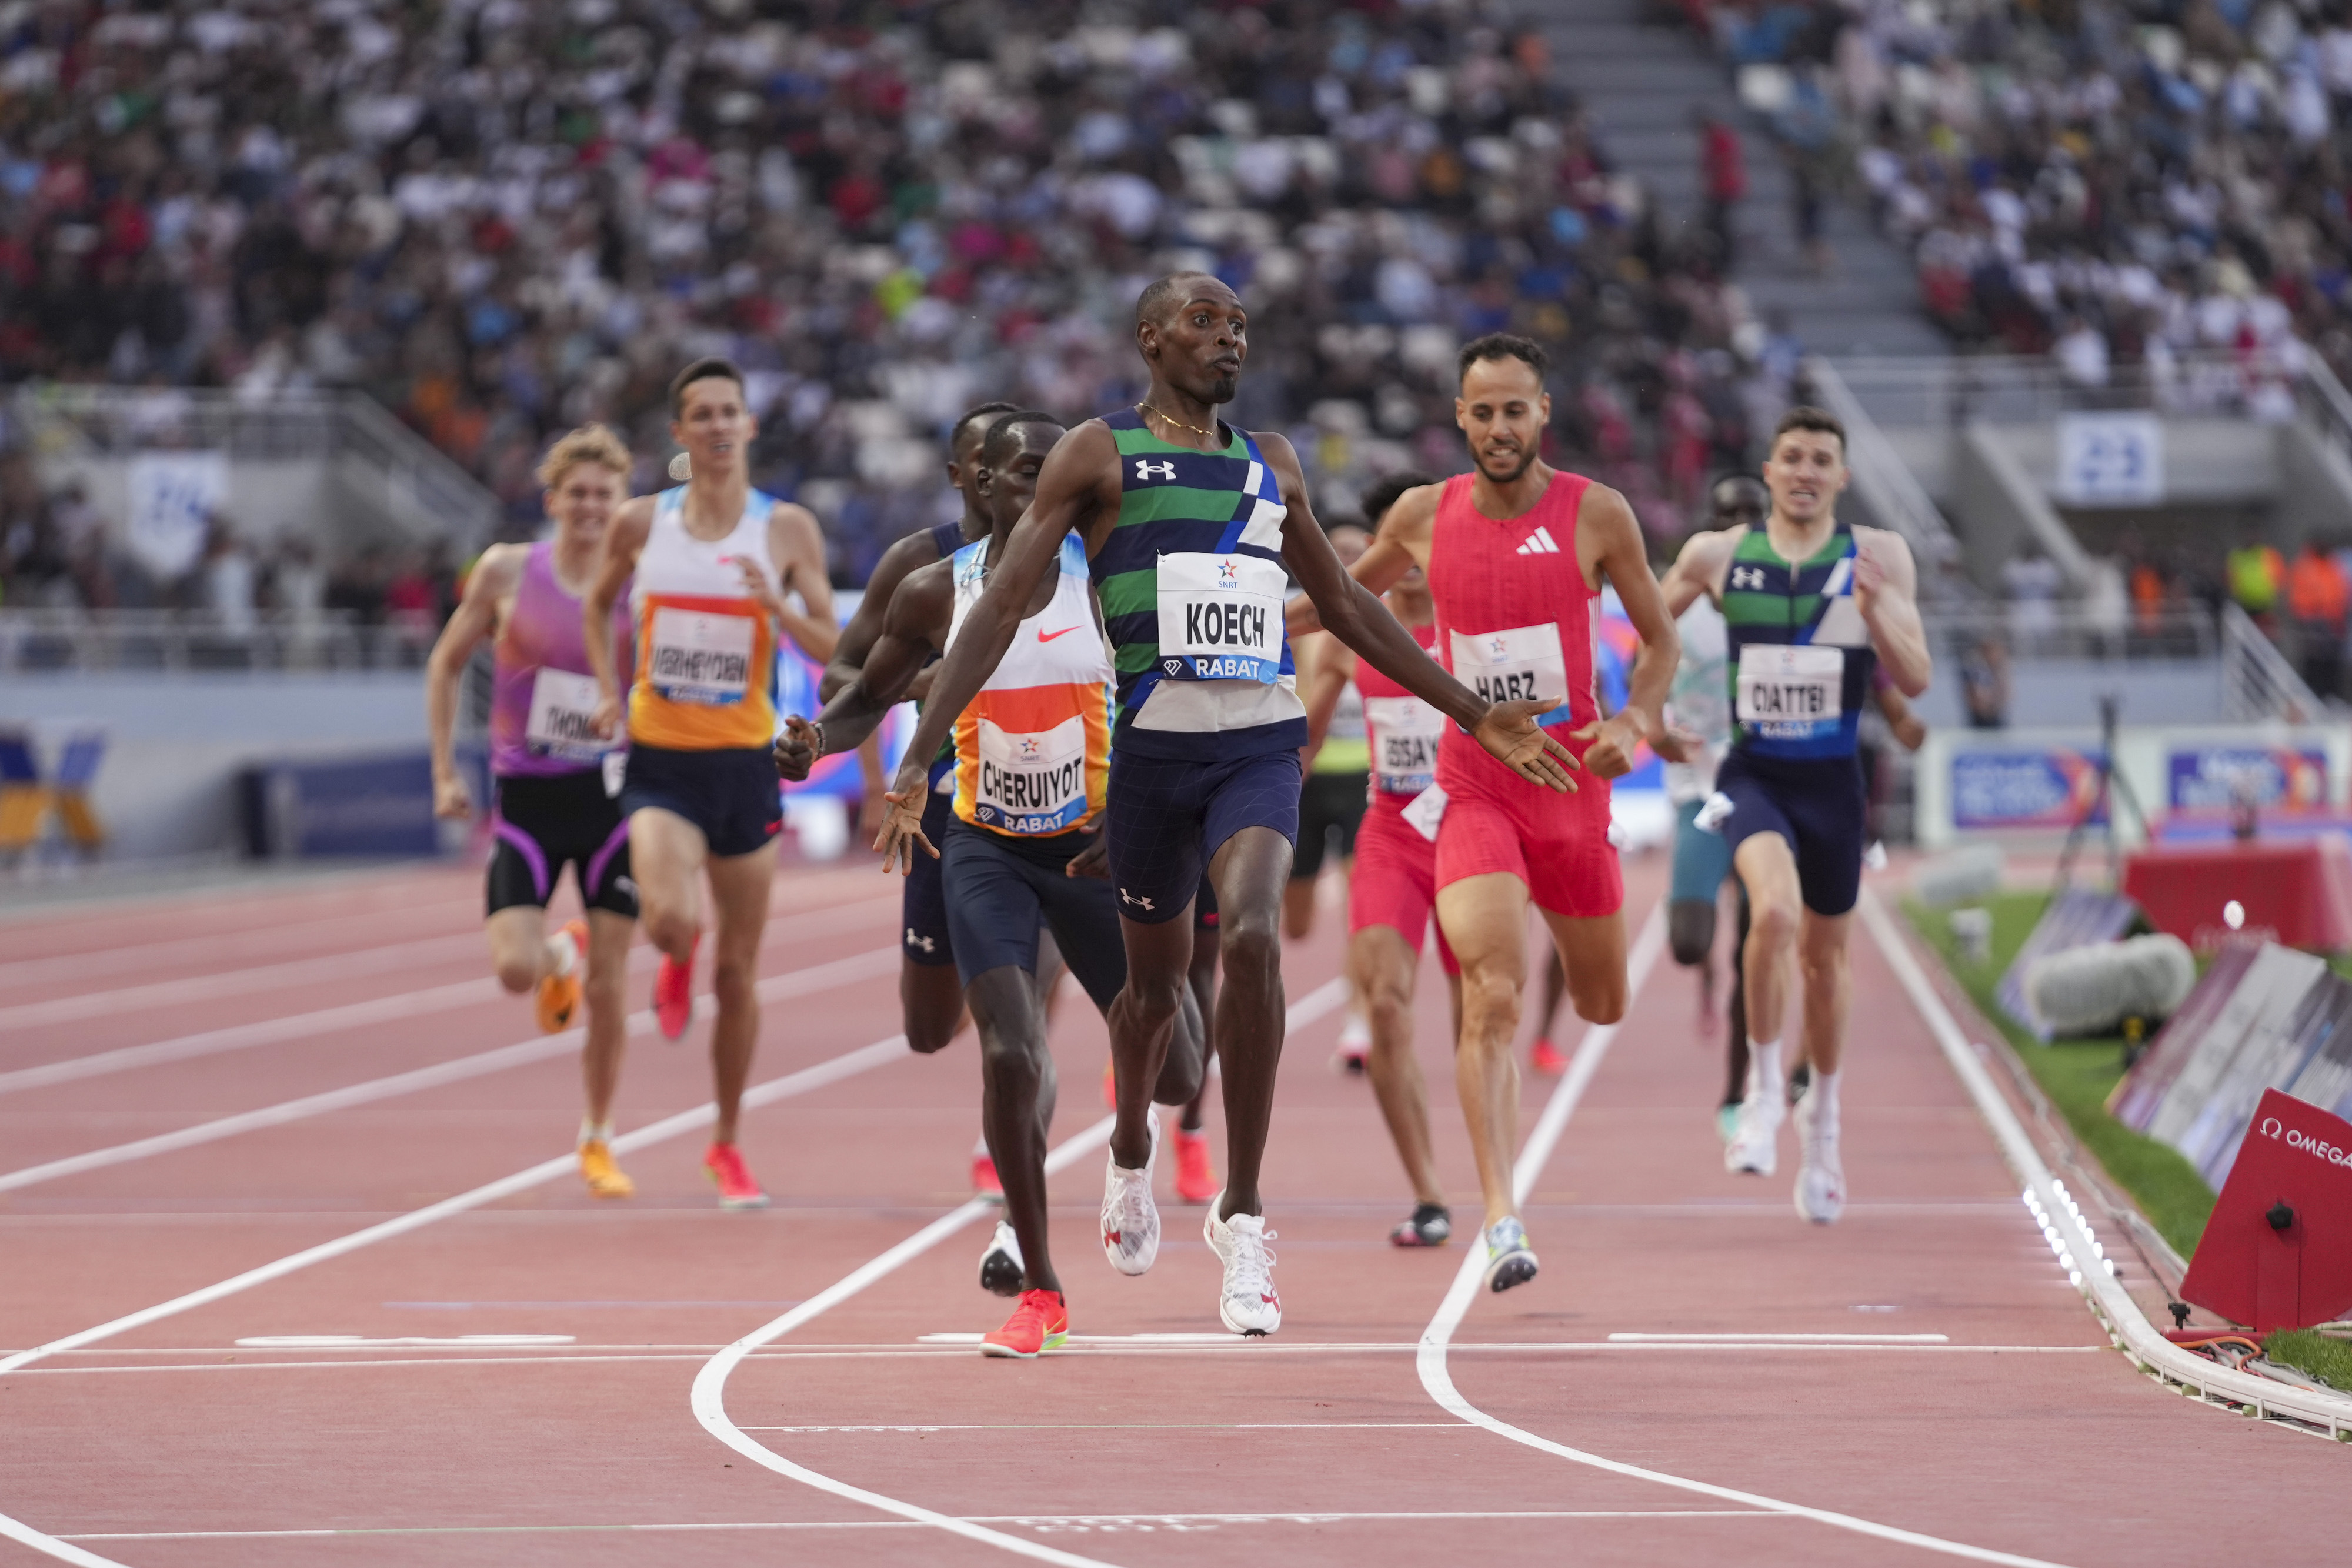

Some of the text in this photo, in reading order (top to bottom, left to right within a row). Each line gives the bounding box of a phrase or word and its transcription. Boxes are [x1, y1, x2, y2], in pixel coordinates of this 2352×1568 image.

[1218, 581, 1238, 589] SNRT
[1186, 602, 1265, 648] KOECH
[1196, 659, 1260, 678] RABAT
[983, 756, 1082, 808] CHERUIYOT
[1004, 812, 1064, 832] RABAT
[2286, 1129, 2352, 1171] OMEGA
